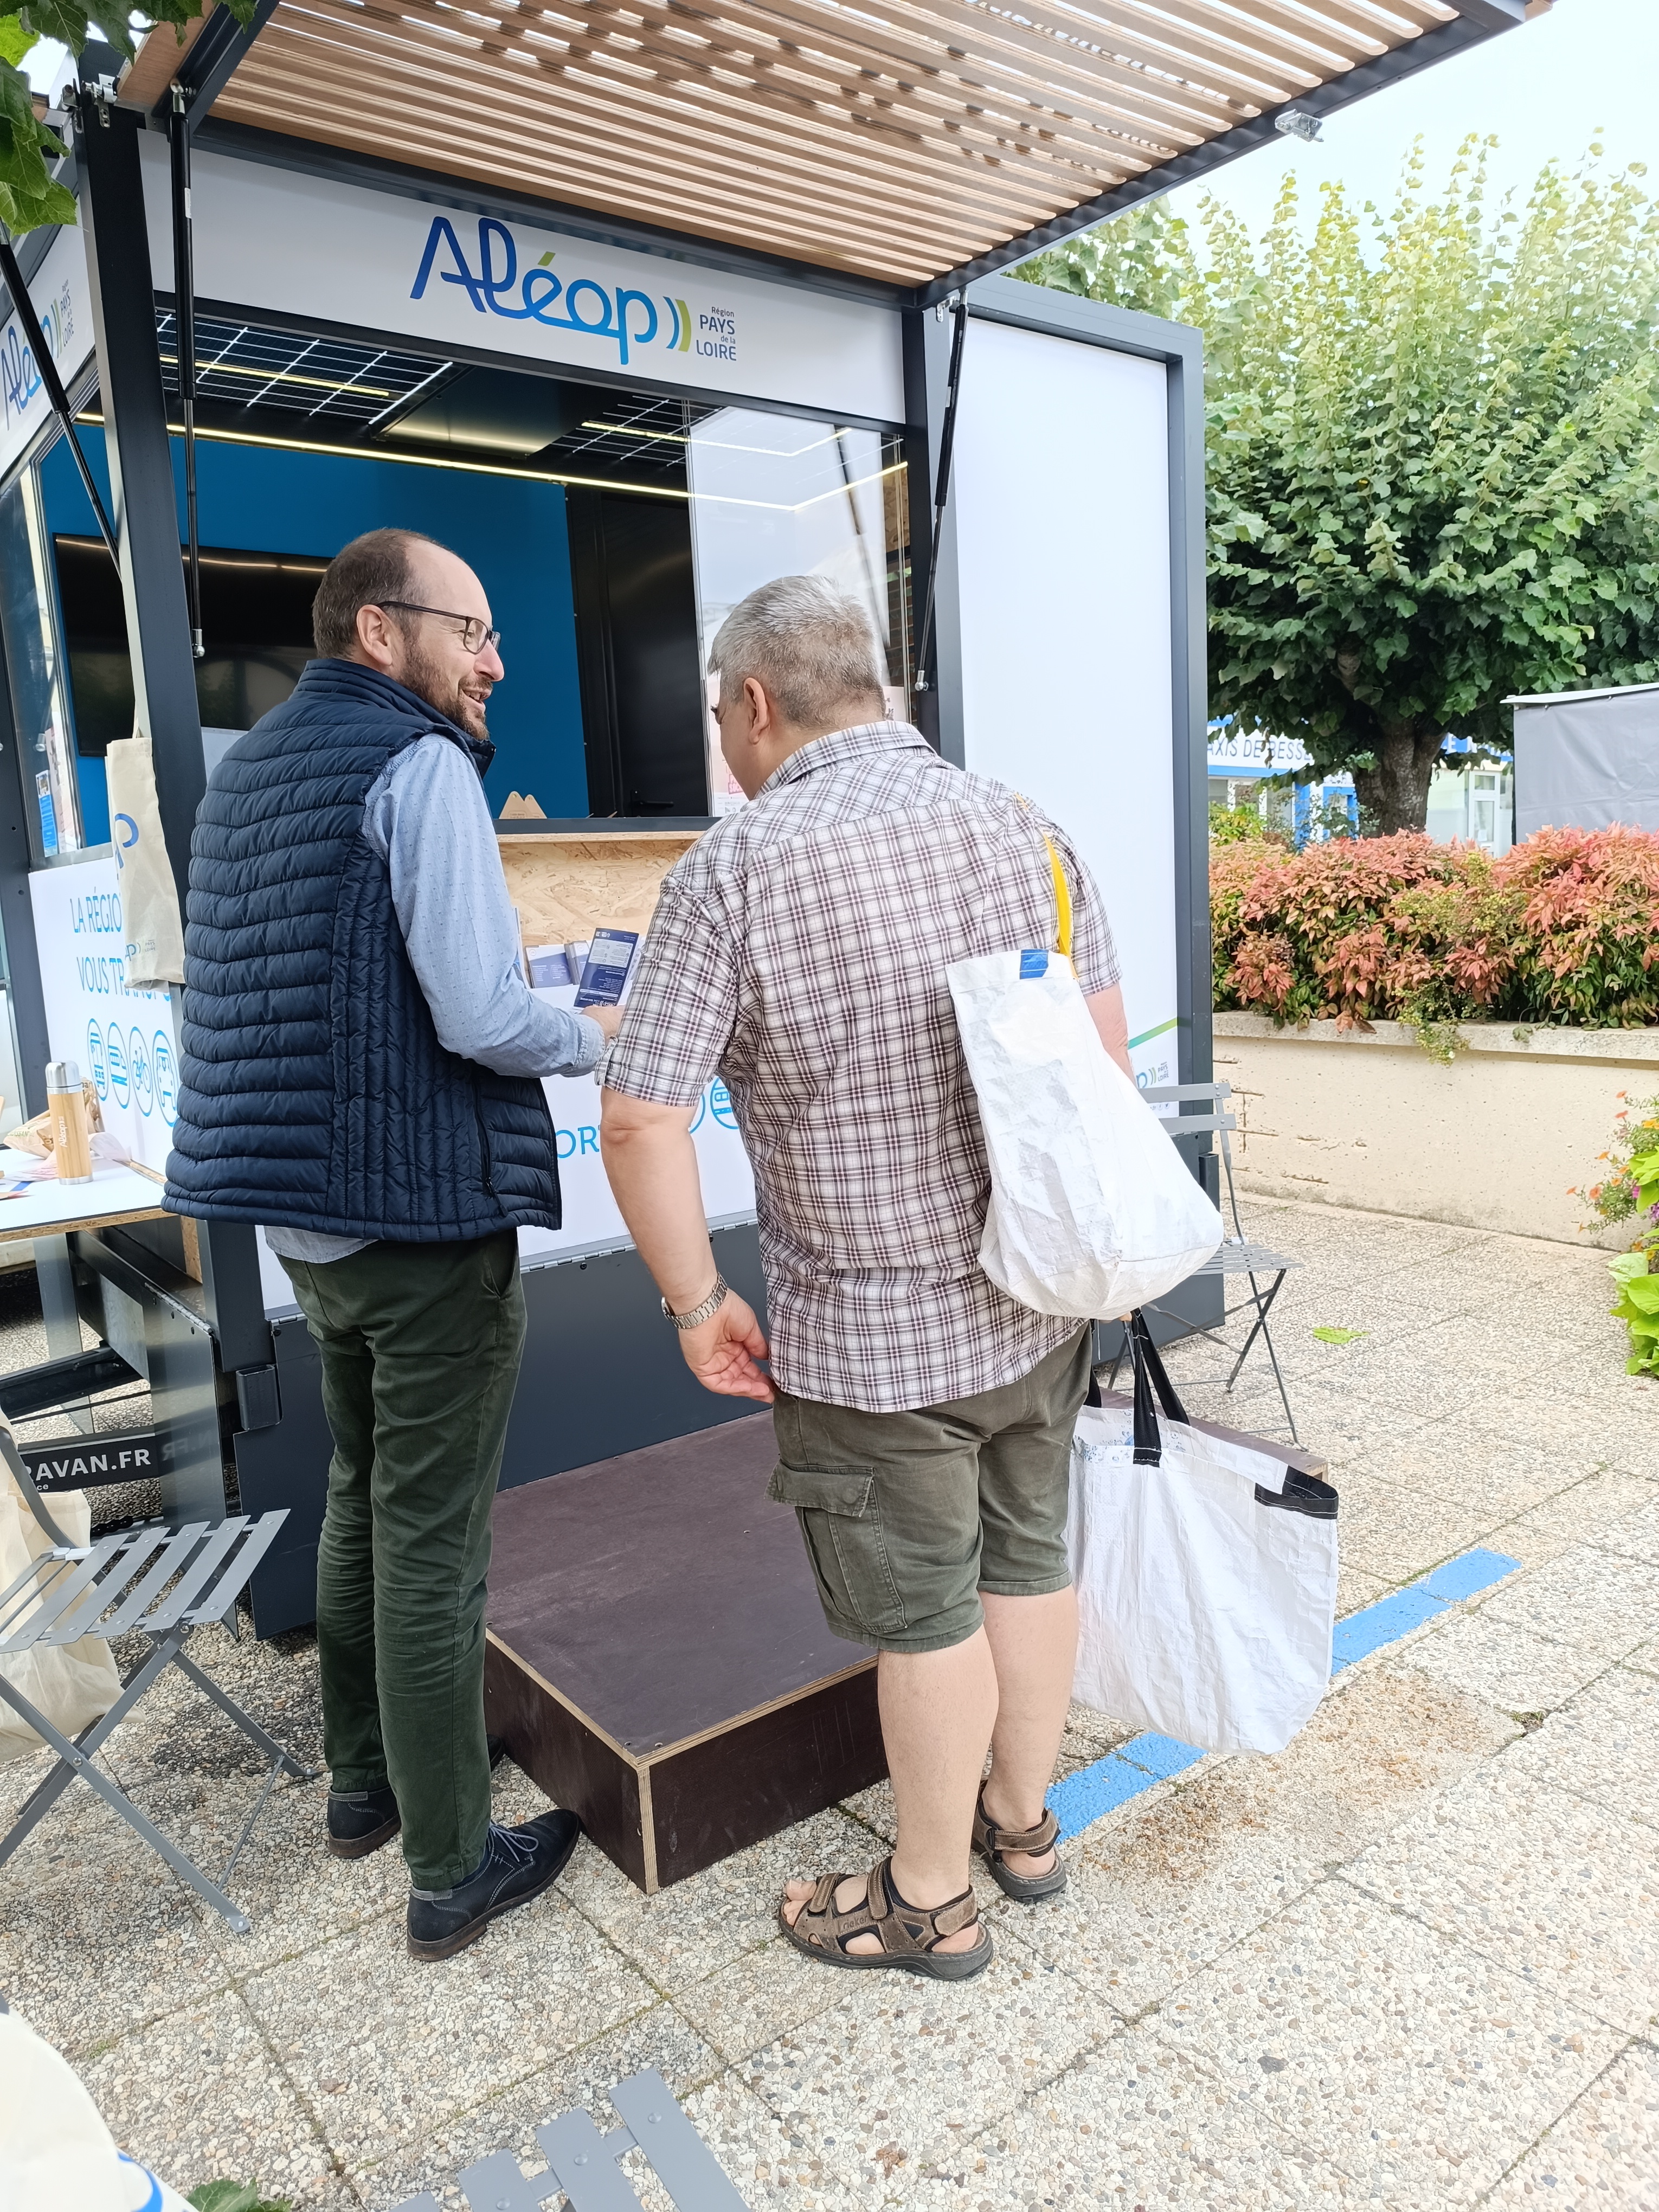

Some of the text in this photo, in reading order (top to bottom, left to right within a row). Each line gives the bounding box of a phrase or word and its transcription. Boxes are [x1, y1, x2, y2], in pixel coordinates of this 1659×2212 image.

[410, 216, 658, 365] Aléop
[711, 306, 735, 318] Région
[699, 314, 735, 335] PAYS
[696, 339, 737, 361] LOIRE
[721, 335, 736, 344] de la
[70, 886, 122, 933] LA RÉGIO
[76, 956, 110, 994] VOUS
[843, 1915, 868, 1930] rieker
